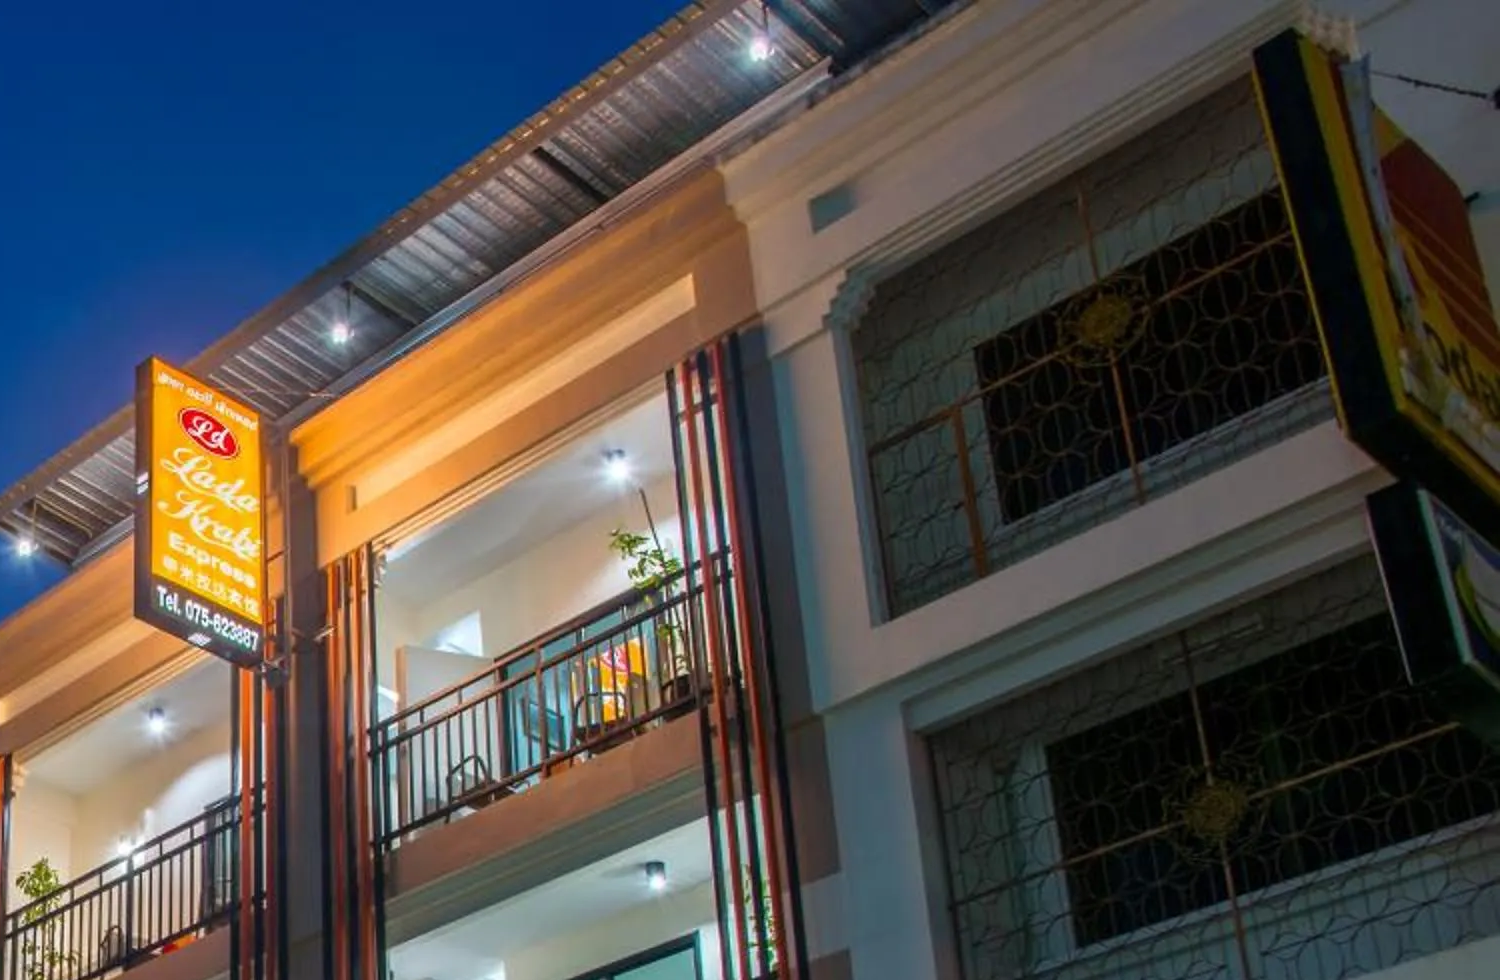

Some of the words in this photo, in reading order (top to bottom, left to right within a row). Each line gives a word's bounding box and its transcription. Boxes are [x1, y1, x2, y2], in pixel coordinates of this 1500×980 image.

[160, 447, 260, 513] Lada
[158, 491, 261, 562] Krabi
[168, 531, 256, 589] Express
[157, 585, 181, 617] Tel.
